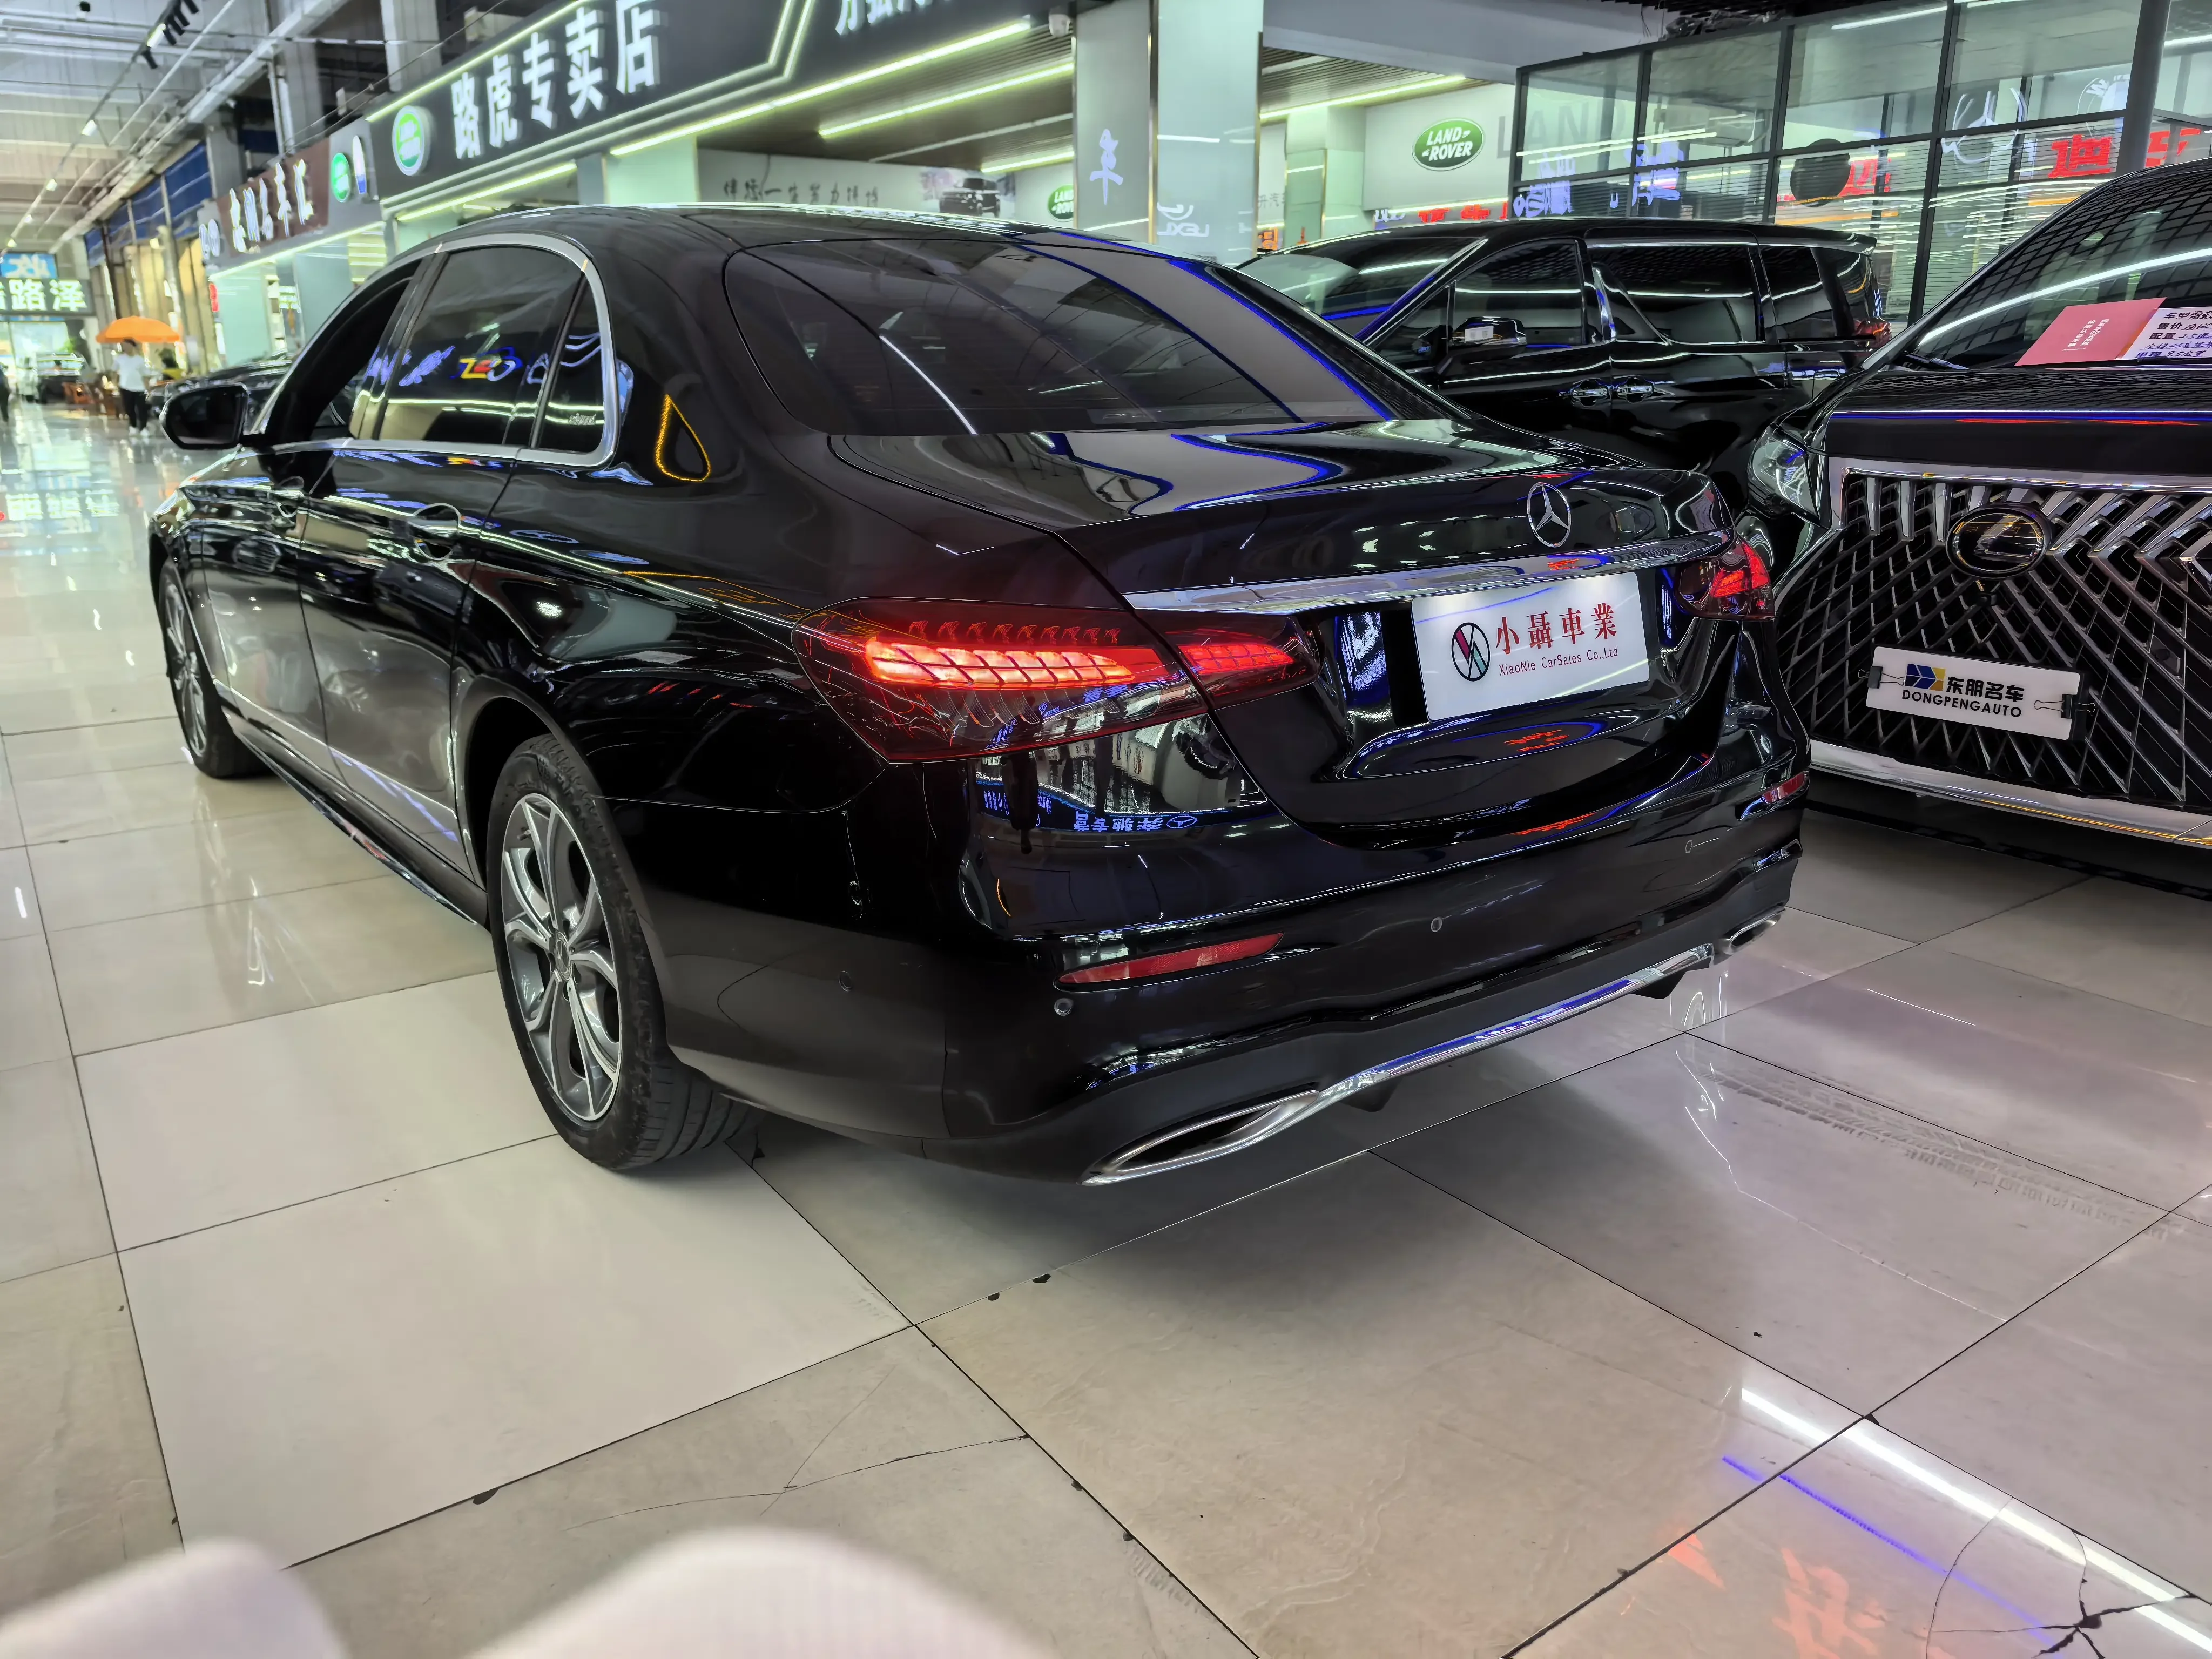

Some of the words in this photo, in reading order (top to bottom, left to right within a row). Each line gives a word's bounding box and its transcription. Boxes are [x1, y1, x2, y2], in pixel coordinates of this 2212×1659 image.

[451, 0, 658, 159] 路虎专卖店
[1426, 127, 1462, 146] LAND
[1428, 141, 1473, 161] ROVER
[1495, 603, 1617, 655] 小聶車業
[1499, 660, 1536, 676] XiaoNie
[1541, 652, 1582, 669] CarSales
[1587, 645, 1618, 661] Co.,Ltd
[1901, 689, 2022, 718] DONGPENGAUTO
[1946, 676, 2025, 703] 东朋名车
